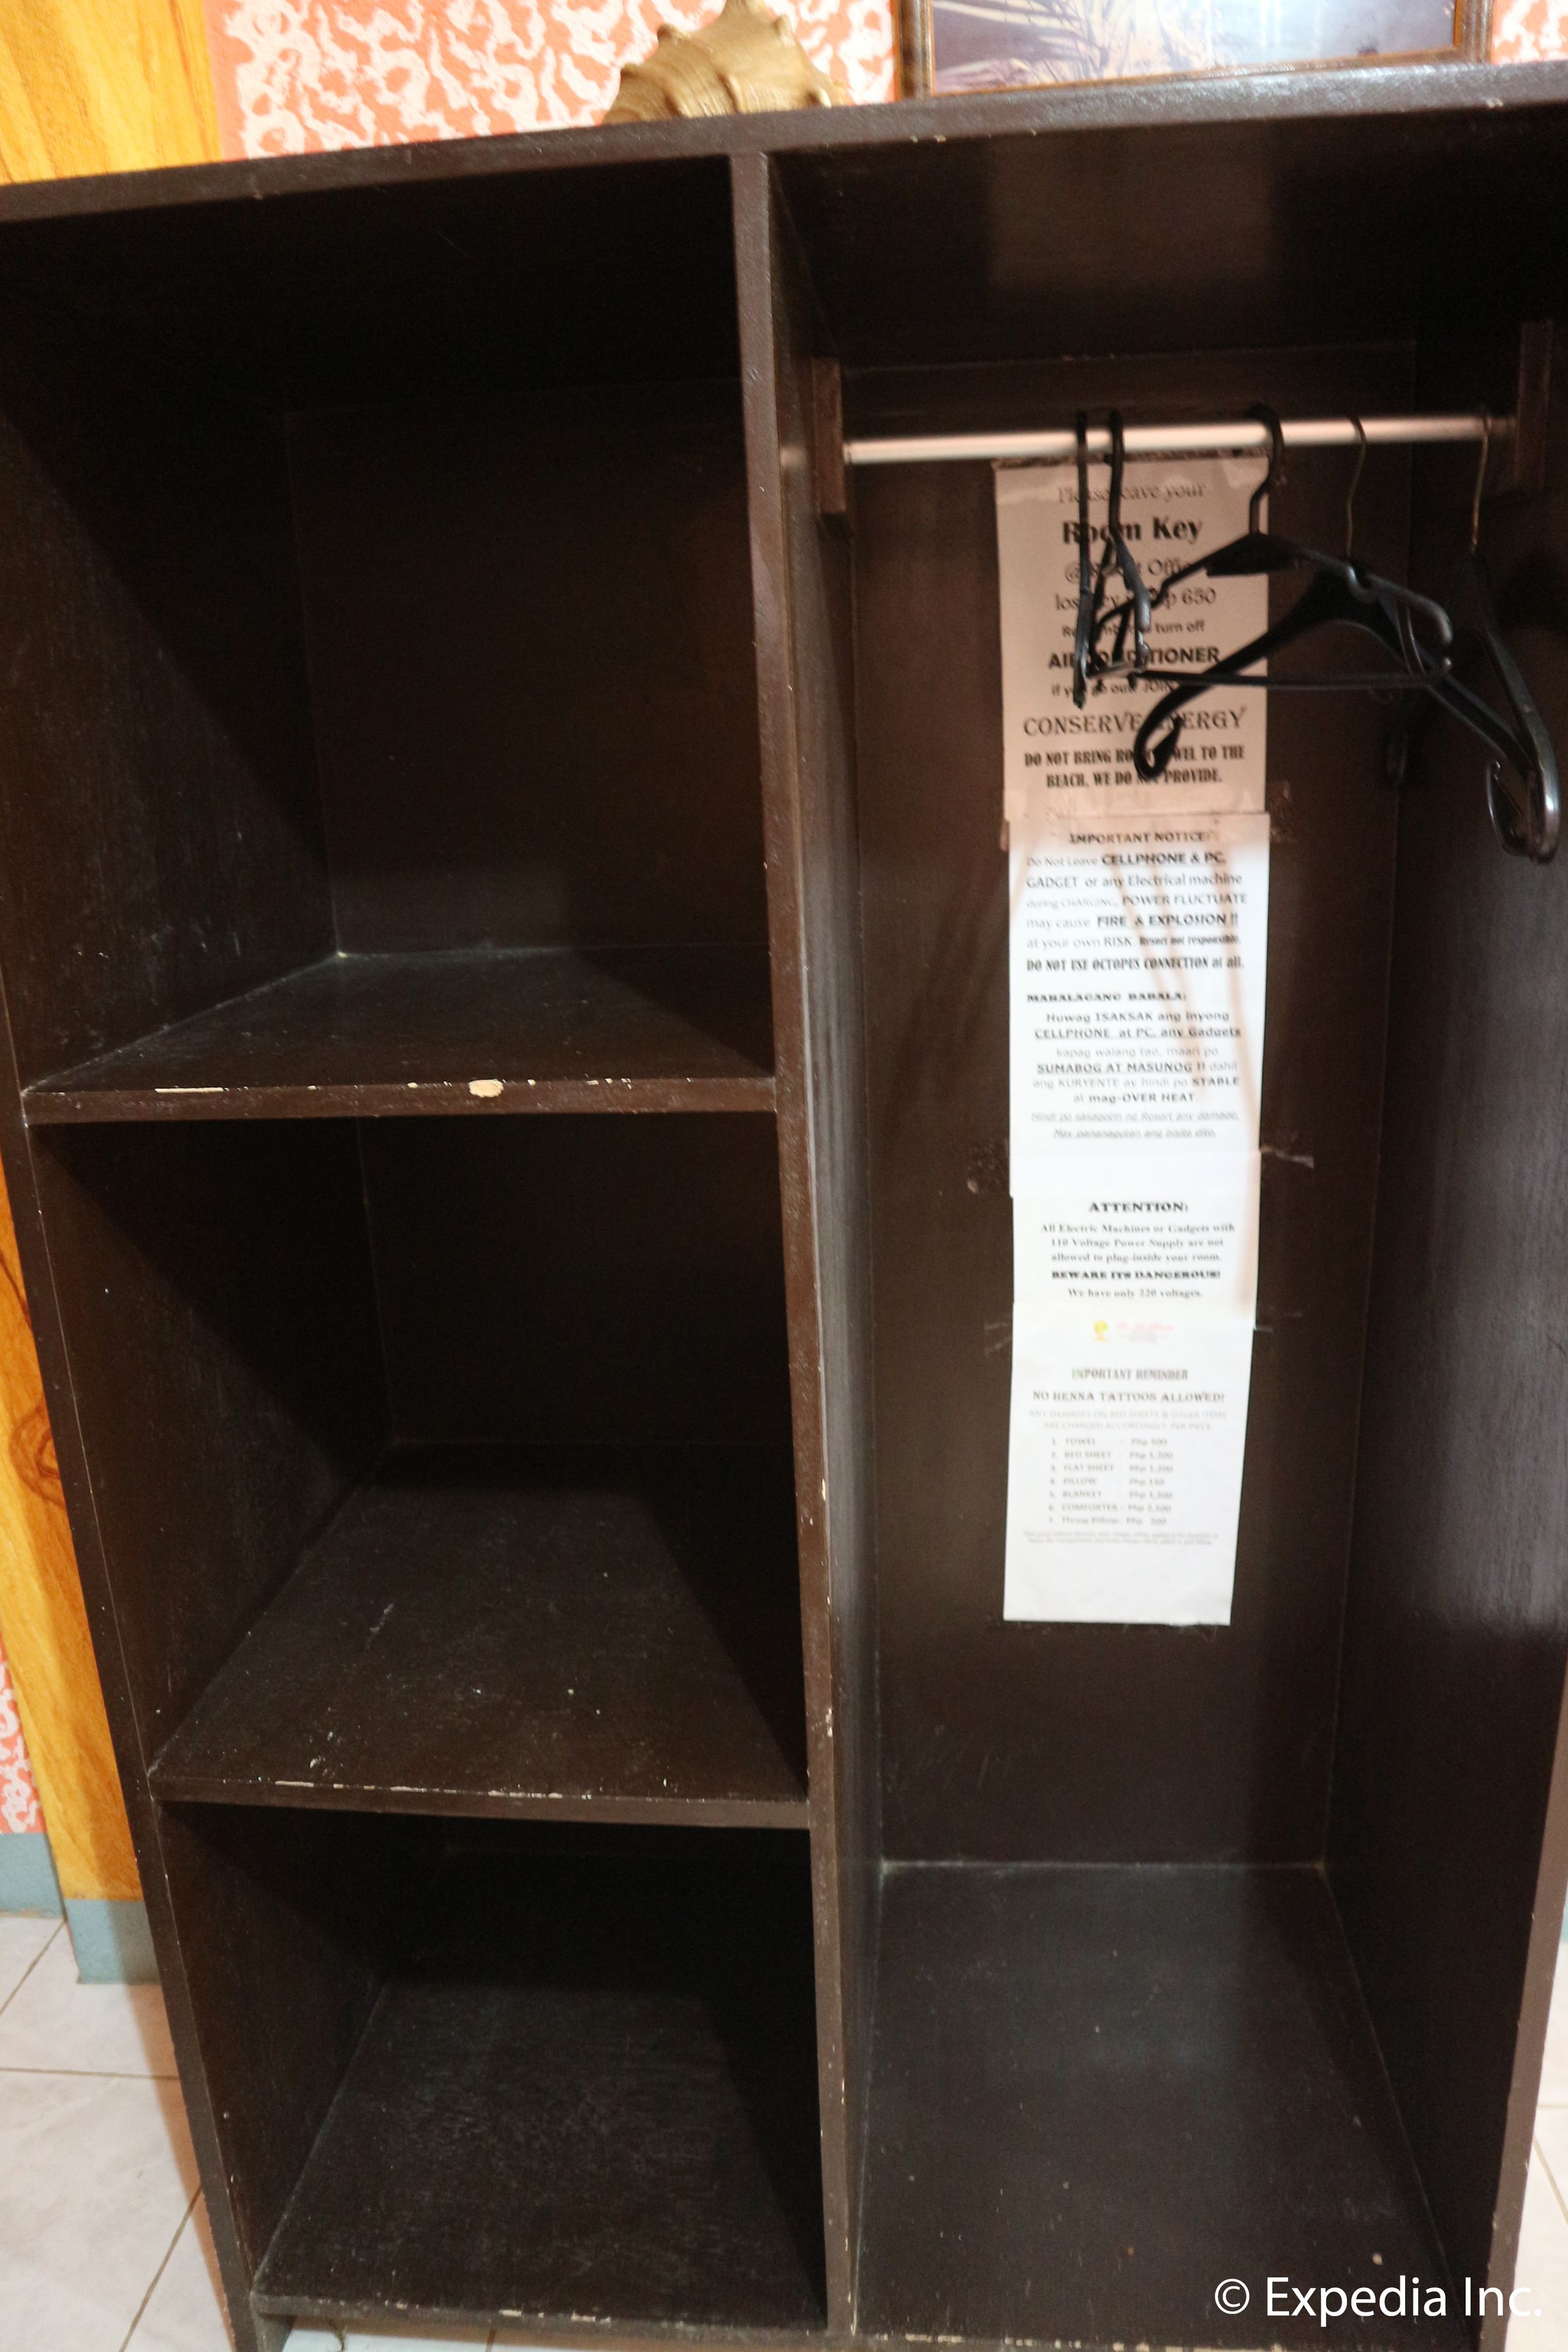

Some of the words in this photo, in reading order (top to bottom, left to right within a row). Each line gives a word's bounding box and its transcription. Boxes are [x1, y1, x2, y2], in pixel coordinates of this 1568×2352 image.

[1163, 484, 1205, 502] your
[1152, 516, 1203, 545] Key
[1156, 622, 1182, 633] turn
[1186, 620, 1205, 632] off
[1023, 711, 1142, 736] CONSERVE
[1024, 752, 1041, 766] DO
[1046, 751, 1069, 766] NOT
[1073, 749, 1112, 764] BRING
[1201, 745, 1217, 760] TO
[1222, 745, 1245, 760] THE
[1093, 771, 1112, 786] WE
[1115, 771, 1133, 785] DO
[1069, 832, 1150, 844] IMPORTANT
[1102, 853, 1186, 866] CELLPHONE
[1027, 877, 1079, 888] GADGET
[1085, 878, 1097, 887] or
[1102, 878, 1123, 890] any
[1128, 873, 1186, 887] Electrical
[1189, 873, 1242, 886] machine
[1123, 894, 1170, 907] POWER
[1174, 893, 1247, 905] FLUCTUATE
[1098, 916, 1127, 928] FIRE
[1149, 913, 1226, 927] EXPLOSION
[1027, 959, 1042, 971] DO
[1046, 959, 1066, 971] NOT
[1071, 959, 1087, 971] USE
[1144, 956, 1208, 970] CONNECTION
[1027, 993, 1121, 1003] MAHALAGANG
[1046, 1013, 1090, 1024] Huwag
[1096, 1012, 1153, 1022] ISAKSAK
[1158, 1013, 1181, 1023] ang
[1035, 1028, 1110, 1039] CELLPHONE
[1119, 1028, 1132, 1038] at
[1037, 1063, 1102, 1073] SUMABOG
[1107, 1063, 1121, 1072] AT
[1127, 1063, 1192, 1072] MASUNOG
[1192, 1077, 1240, 1087] STABLE
[1089, 1201, 1188, 1213] ATTENTION:
[1042, 1223, 1056, 1232] All
[1059, 1223, 1097, 1232] Electric
[1102, 1223, 1150, 1232] Machines
[1213, 1223, 1235, 1232] with
[1051, 1253, 1090, 1262] allowed
[1051, 1270, 1107, 1280] BEWARE
[1071, 1368, 1131, 1380] IMPORTANT
[1136, 1368, 1188, 1381] REMINDER
[1033, 1390, 1049, 1401] NO
[1053, 1390, 1095, 1401] HENNA
[1099, 1391, 1157, 1402] TATTOOS
